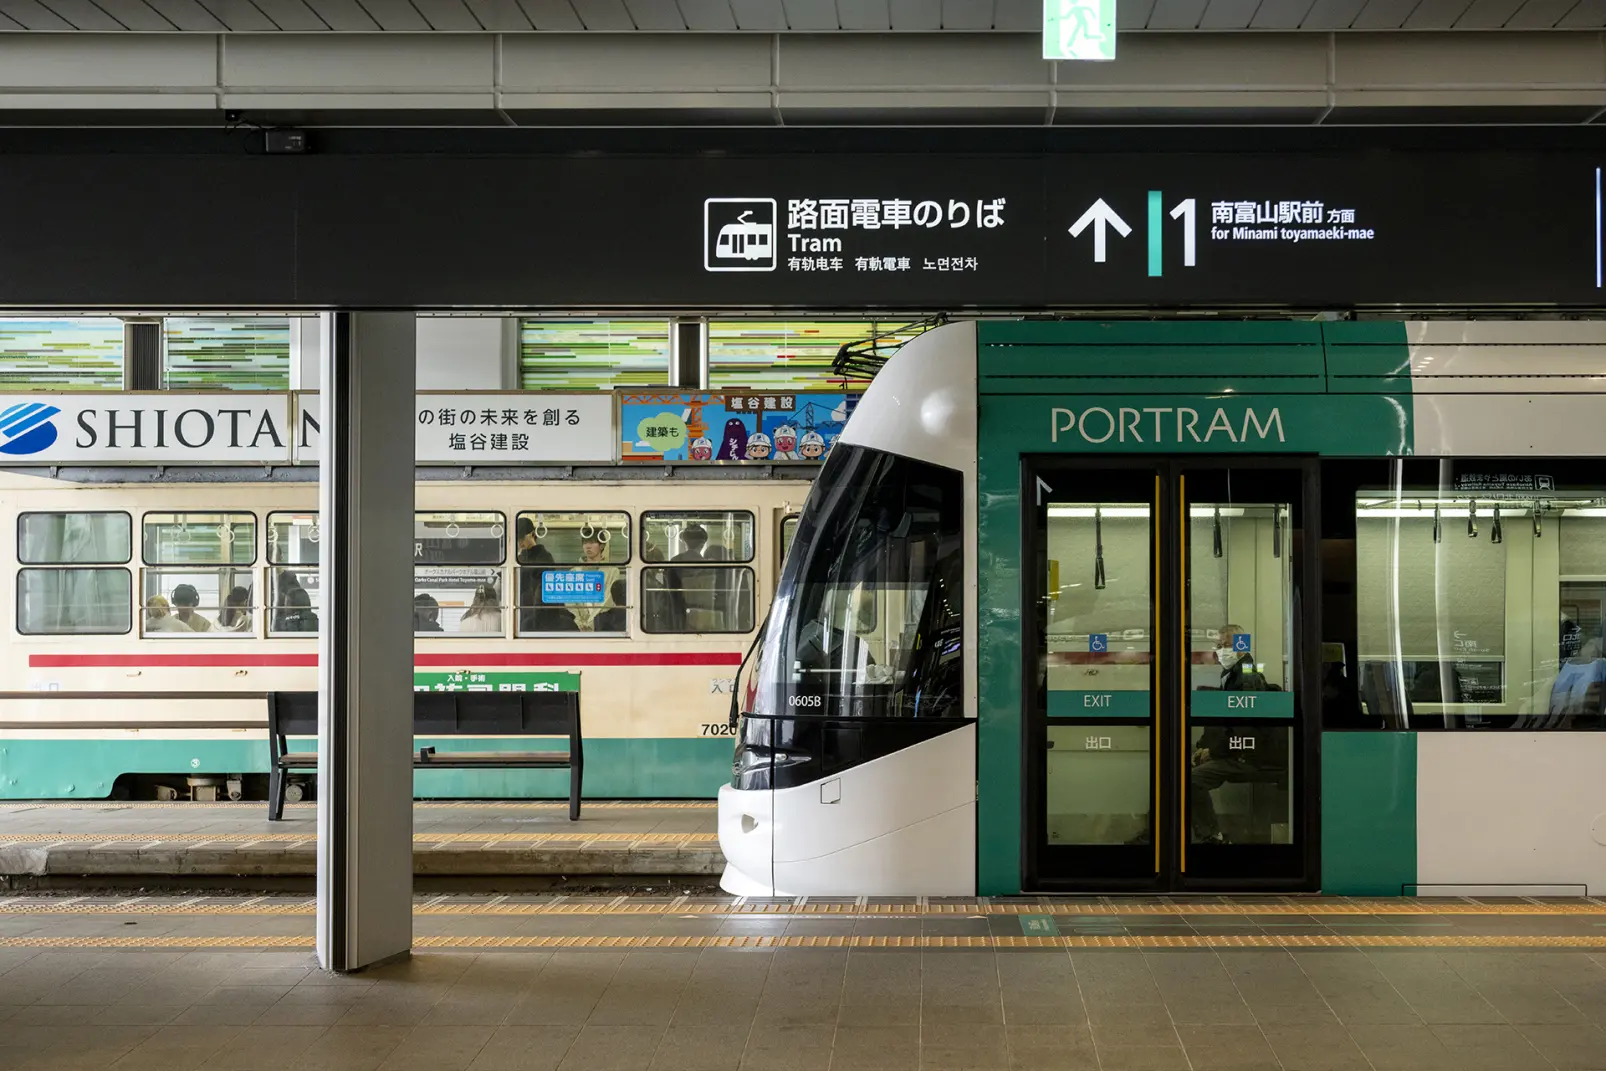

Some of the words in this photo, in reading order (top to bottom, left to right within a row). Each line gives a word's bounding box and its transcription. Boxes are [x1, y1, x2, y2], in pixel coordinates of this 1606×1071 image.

[787, 197, 1007, 230] 路面電車のりば
[1210, 200, 1325, 226] 南富山駅前
[1326, 208, 1356, 225] 方面
[1169, 198, 1196, 267] 1
[1210, 226, 1231, 240] for
[1232, 226, 1279, 240] Minami
[1279, 226, 1375, 243] toyamaeki-mae
[787, 234, 842, 253] Tram
[787, 256, 844, 272] 有轨电车
[854, 256, 911, 272] 有軌電車
[922, 256, 979, 272] 노면전차
[646, 425, 679, 438] 建築も
[1051, 406, 1286, 444] PORTRAM
[448, 432, 530, 451] 塩谷建設
[788, 694, 822, 707] 0605B
[1083, 694, 1112, 708] EXIT
[1227, 695, 1257, 709] EXIT
[701, 723, 738, 736] 7020
[1085, 735, 1112, 750] 出口
[1229, 735, 1256, 750] 出口
